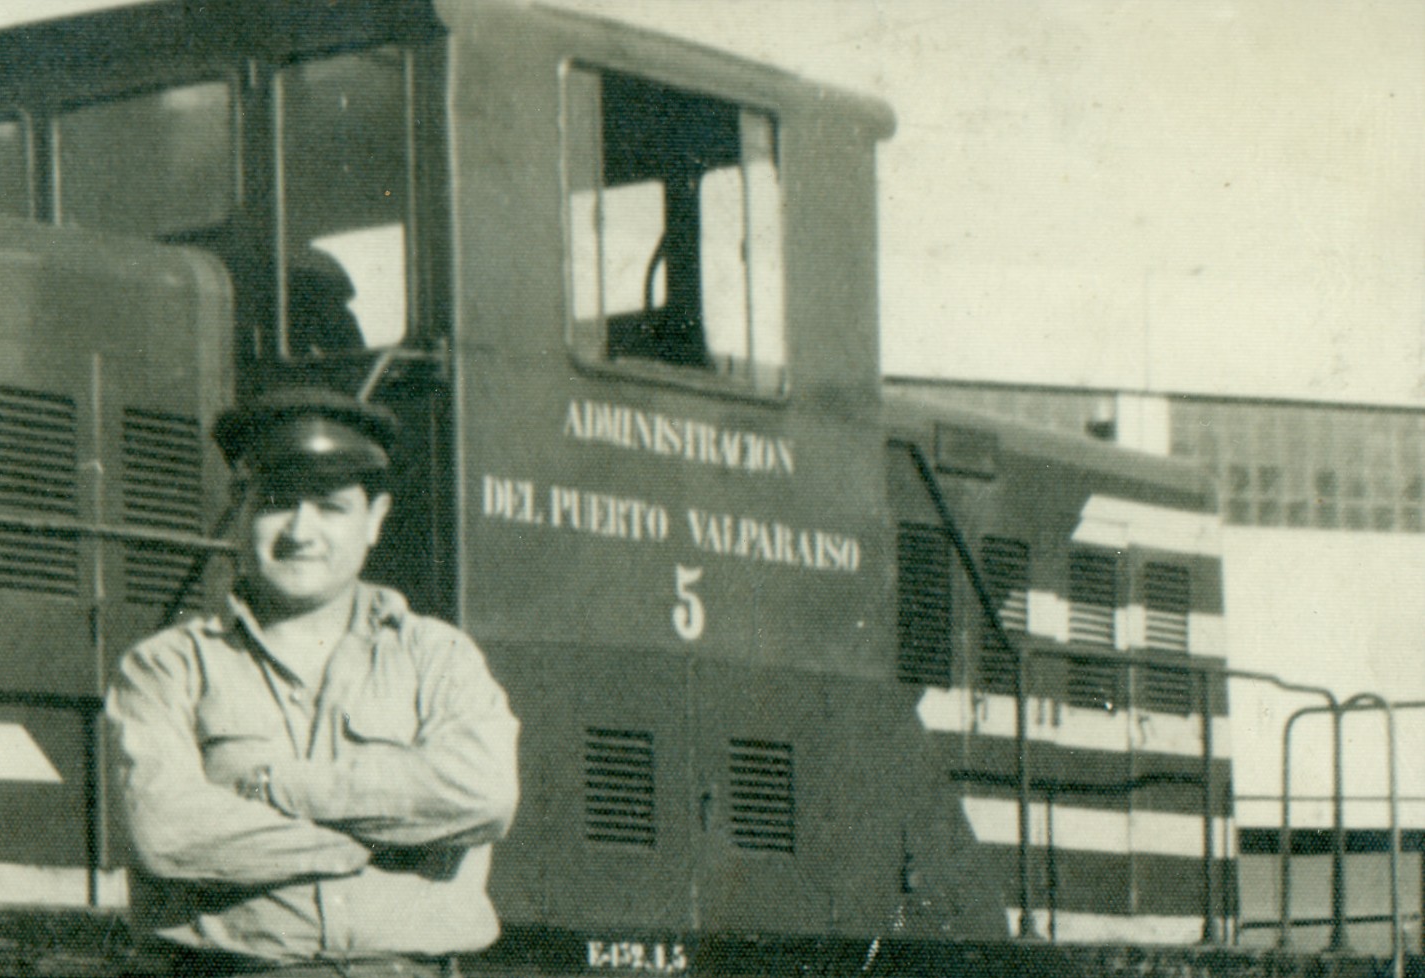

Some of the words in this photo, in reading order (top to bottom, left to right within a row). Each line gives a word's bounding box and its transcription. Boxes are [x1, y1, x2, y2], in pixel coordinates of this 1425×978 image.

[565, 400, 794, 474] ADMINISTRACION
[483, 475, 543, 524] DEL
[550, 486, 670, 541] PUERTO
[687, 508, 860, 572] VALPARAISO
[673, 564, 704, 641] 5
